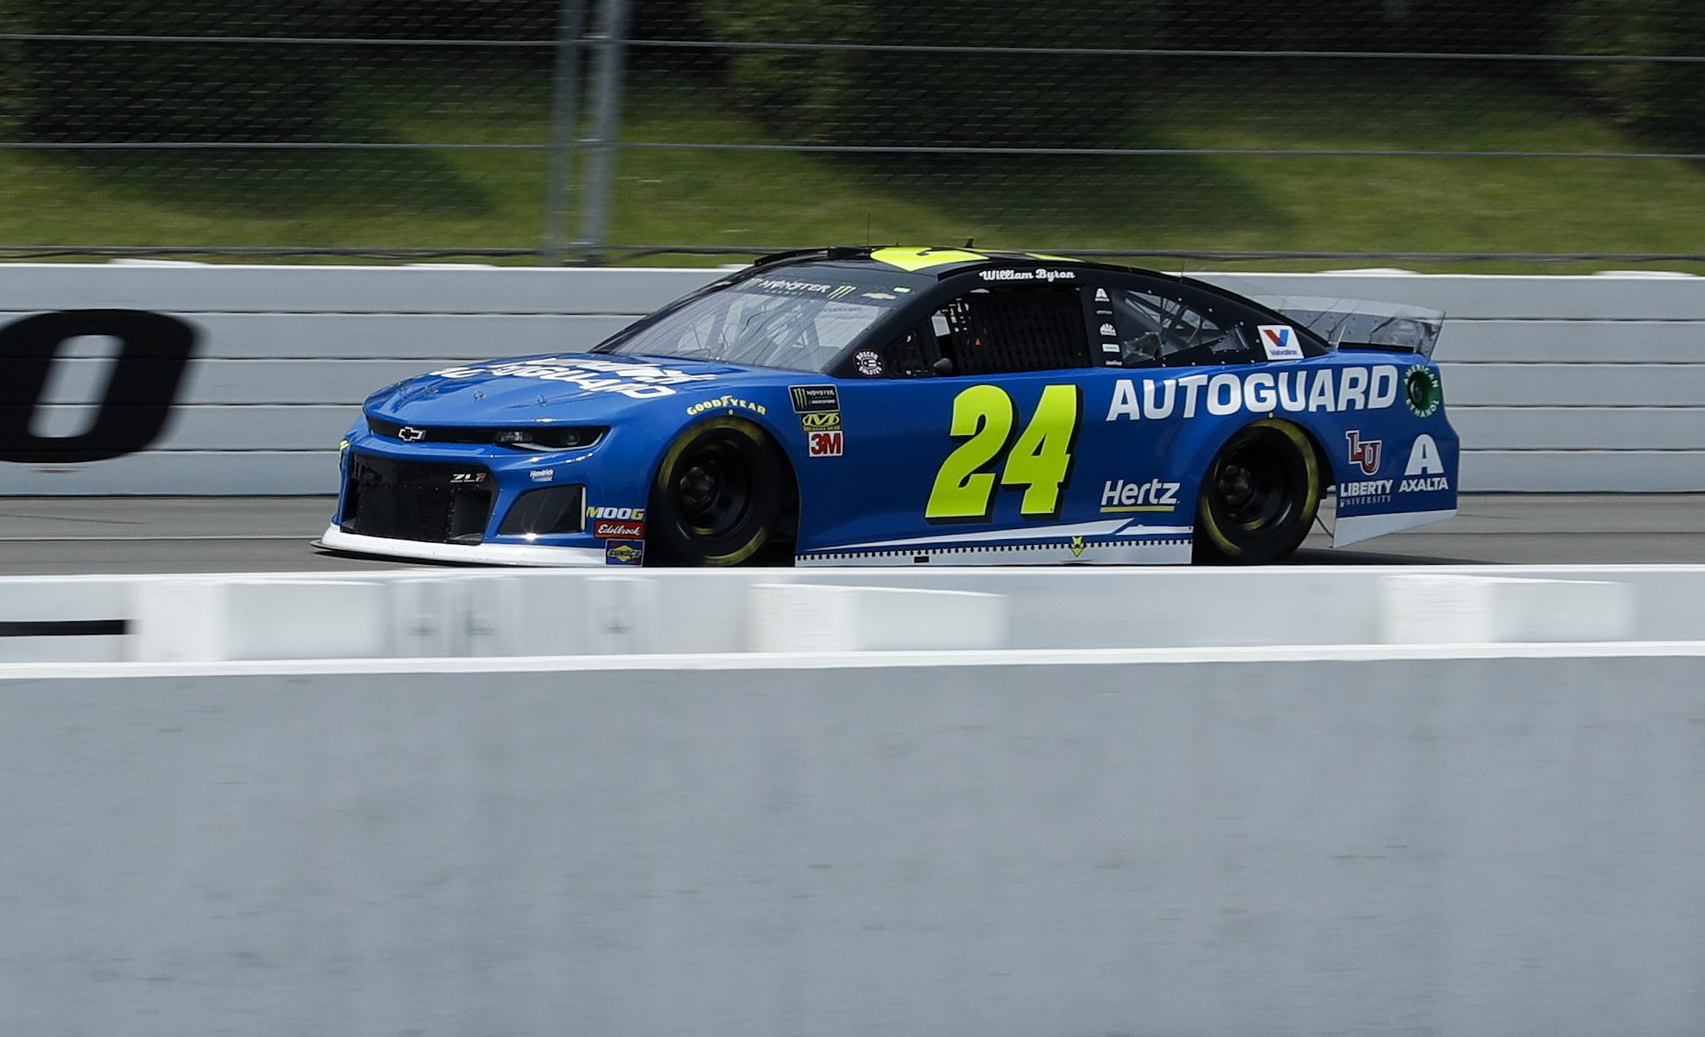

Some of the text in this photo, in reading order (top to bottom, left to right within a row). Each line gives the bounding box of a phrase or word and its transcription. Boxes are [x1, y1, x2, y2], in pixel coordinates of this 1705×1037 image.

[978, 268, 1075, 282] William Byron
[758, 279, 831, 294] MONSTER
[1404, 364, 1439, 388] AMERICAN
[1106, 365, 1398, 421] AUTOGUARD
[686, 395, 767, 416] GOODYEAR
[811, 433, 841, 455] 3M
[925, 384, 1078, 518] 24
[1100, 478, 1179, 506] Hertz
[1340, 479, 1394, 497] LIBERTY
[1398, 477, 1449, 493] AXALTA
[586, 506, 645, 520] MOOG
[597, 523, 641, 536] Edelbrock
